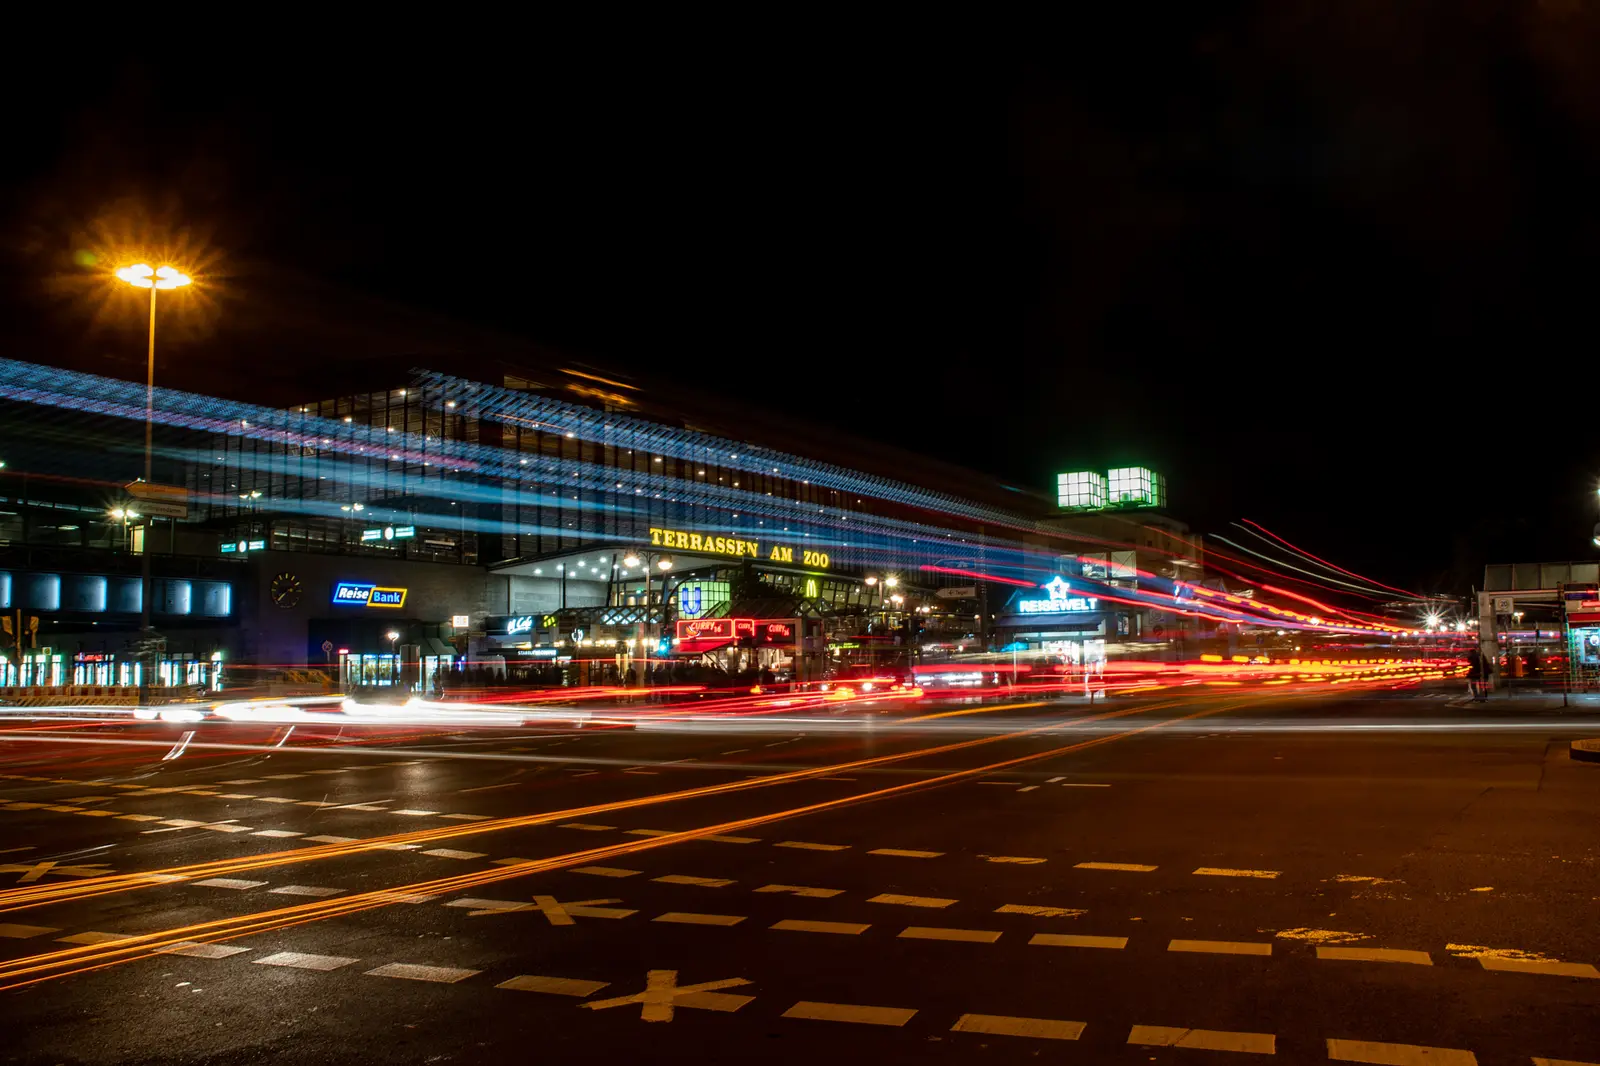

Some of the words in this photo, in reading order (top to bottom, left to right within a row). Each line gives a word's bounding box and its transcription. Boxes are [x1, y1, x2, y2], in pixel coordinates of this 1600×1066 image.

[649, 527, 758, 557] TERRASSEN
[770, 546, 793, 562] AM
[803, 550, 829, 567] ZOO
[338, 587, 369, 599] Reise
[373, 591, 400, 602] Bank
[682, 587, 701, 614] U
[1019, 598, 1097, 612] REISEWELT
[690, 621, 715, 631] CURRY
[769, 624, 785, 633] CURRY
